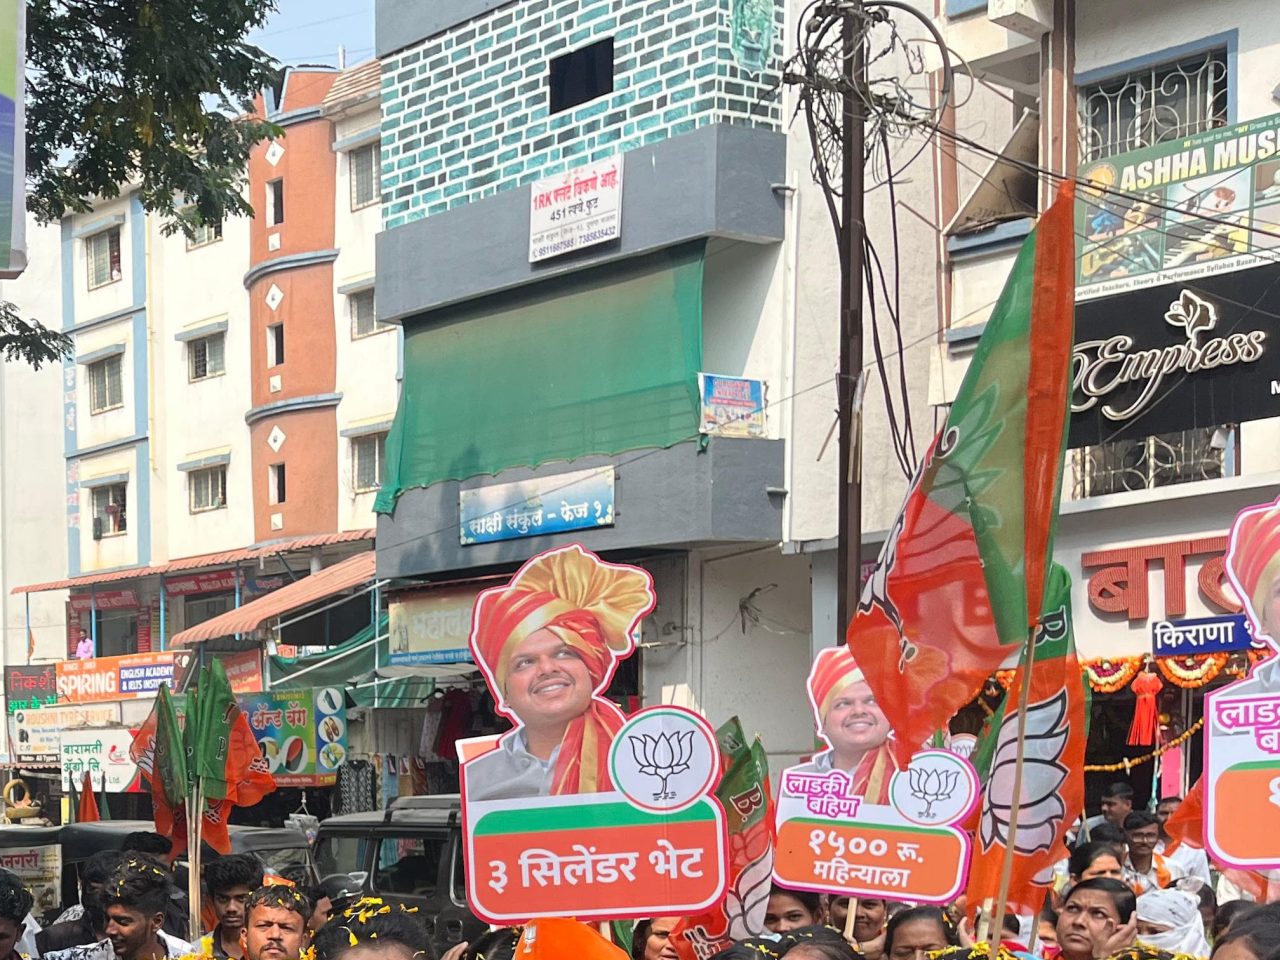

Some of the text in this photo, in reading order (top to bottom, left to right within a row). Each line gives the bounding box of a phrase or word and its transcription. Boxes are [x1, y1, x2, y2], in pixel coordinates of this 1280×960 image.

[1120, 147, 1207, 193] ASHHA
[550, 208, 566, 221] 451
[506, 508, 543, 533] संकुल
[560, 500, 589, 523] फेज
[1153, 620, 1236, 650] किराणा
[56, 670, 117, 697] SPIRING
[121, 665, 174, 680] ENGLISH ACADEMY
[1220, 701, 1280, 726] लाड
[787, 773, 848, 797] लाडकी
[808, 796, 858, 816] बहिण
[808, 829, 889, 857] १५००
[488, 838, 705, 894] ३ सिलेंडर भेट
[812, 857, 912, 888] महिन्याला
